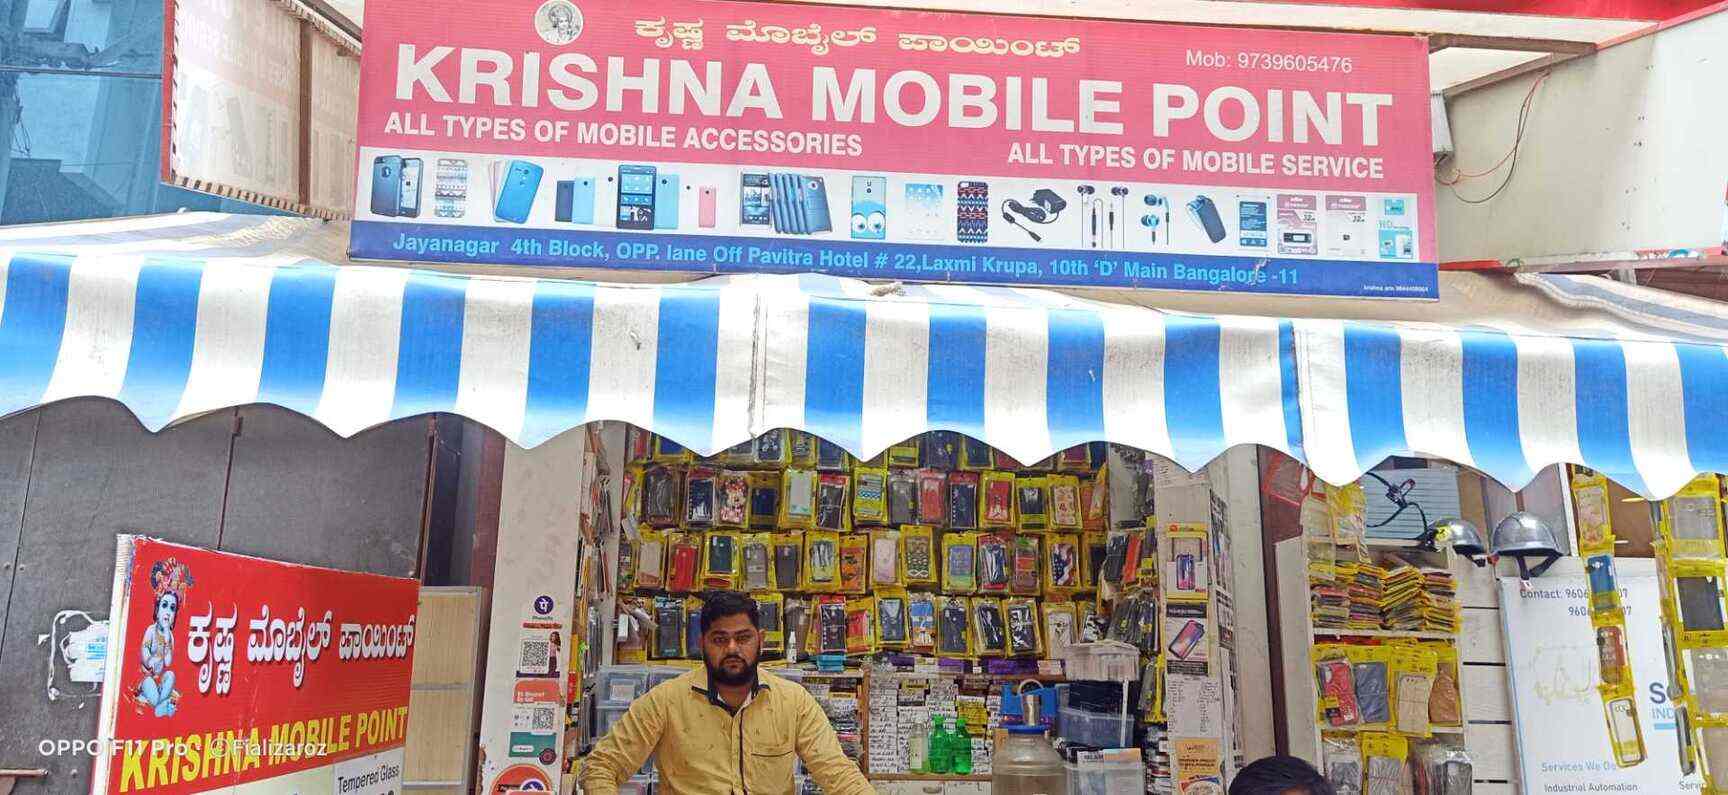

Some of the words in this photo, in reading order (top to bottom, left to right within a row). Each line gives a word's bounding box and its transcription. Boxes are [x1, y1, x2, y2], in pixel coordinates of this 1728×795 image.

[634, 16, 704, 50] ಕೃಷ್ಣ
[726, 19, 877, 55] ಮೊಬೈಲ್
[898, 33, 1080, 58] ಪಾಯಿಂಟ್
[1186, 49, 1233, 68] Mob:
[1237, 51, 1353, 73] 9739605476
[394, 43, 783, 120] KRISHNA
[810, 65, 1124, 136] MOBILE
[1153, 82, 1394, 146] POINT
[384, 111, 436, 137] ALL
[442, 115, 527, 142] TYPES
[533, 119, 570, 143] OF
[577, 122, 677, 149] MOBILE
[682, 126, 863, 158] ACCESSORIES
[1007, 142, 1054, 166] ALL
[1059, 144, 1136, 170] TYPES
[1143, 147, 1176, 171] OF
[1182, 150, 1276, 176] MOBILE
[1281, 153, 1385, 180] SERVICE
[393, 233, 499, 257] Jayanagar
[511, 238, 543, 256] 4th
[549, 239, 610, 261] Block,
[616, 242, 660, 260] OPP.
[666, 245, 706, 263] lane
[713, 246, 743, 264] Off
[750, 249, 813, 267] Pavitra
[819, 252, 868, 269] Hotel
[873, 254, 889, 269] #
[982, 257, 1042, 278] Krupa,
[1049, 260, 1089, 277] 10th
[1124, 264, 1167, 280] Main
[1174, 264, 1267, 286] Bangalore
[187, 601, 237, 694] ಕೃಷ್ಣ
[247, 604, 332, 687] ಮೊಬೈಲ್
[339, 614, 416, 660] ಪಾಯಿಂಟ್
[119, 727, 260, 793] KRISHNA
[269, 714, 351, 767] MOBILE
[355, 706, 408, 749] POINT
